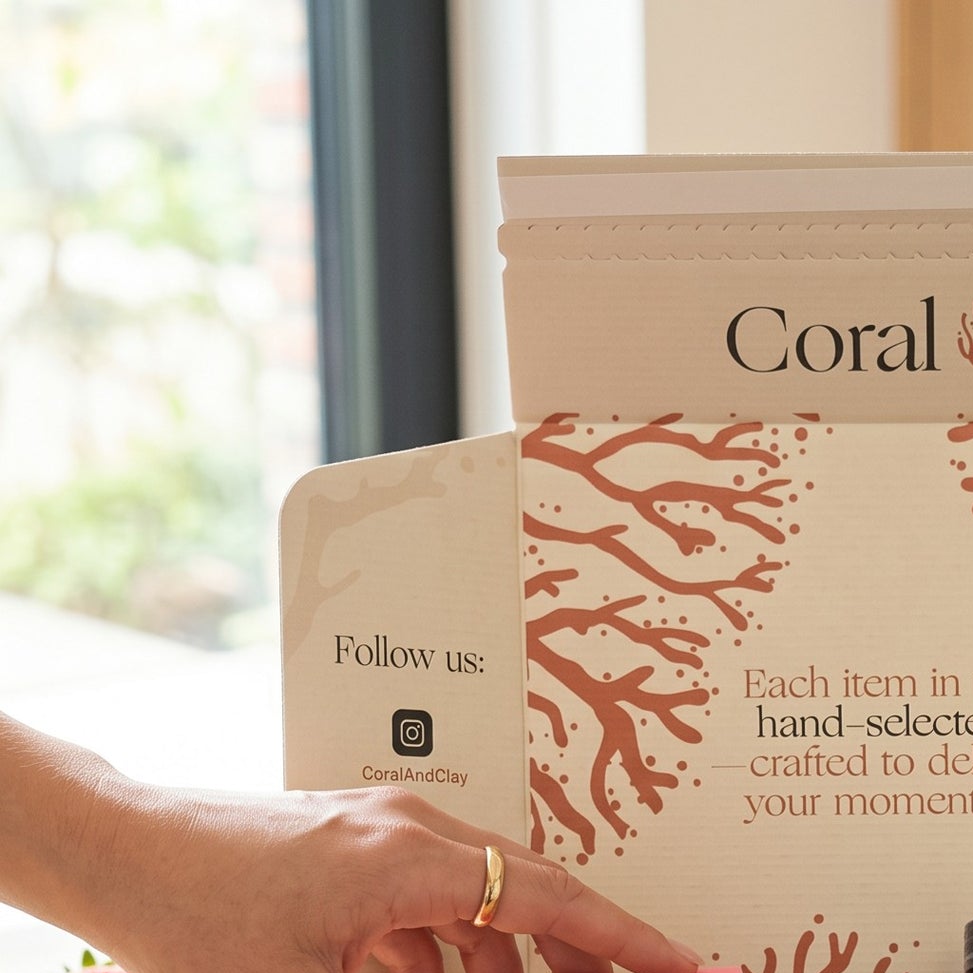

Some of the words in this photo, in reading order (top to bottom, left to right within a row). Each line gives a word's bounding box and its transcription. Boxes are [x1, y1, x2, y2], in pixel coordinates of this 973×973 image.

[726, 295, 942, 373] Coral
[334, 634, 436, 670] Follow
[446, 651, 484, 674] us:
[743, 666, 830, 698] Each
[843, 667, 917, 698] item
[932, 668, 960, 697] in
[362, 765, 468, 787] CoralAndClay
[881, 748, 915, 776] to
[743, 792, 821, 823] your
